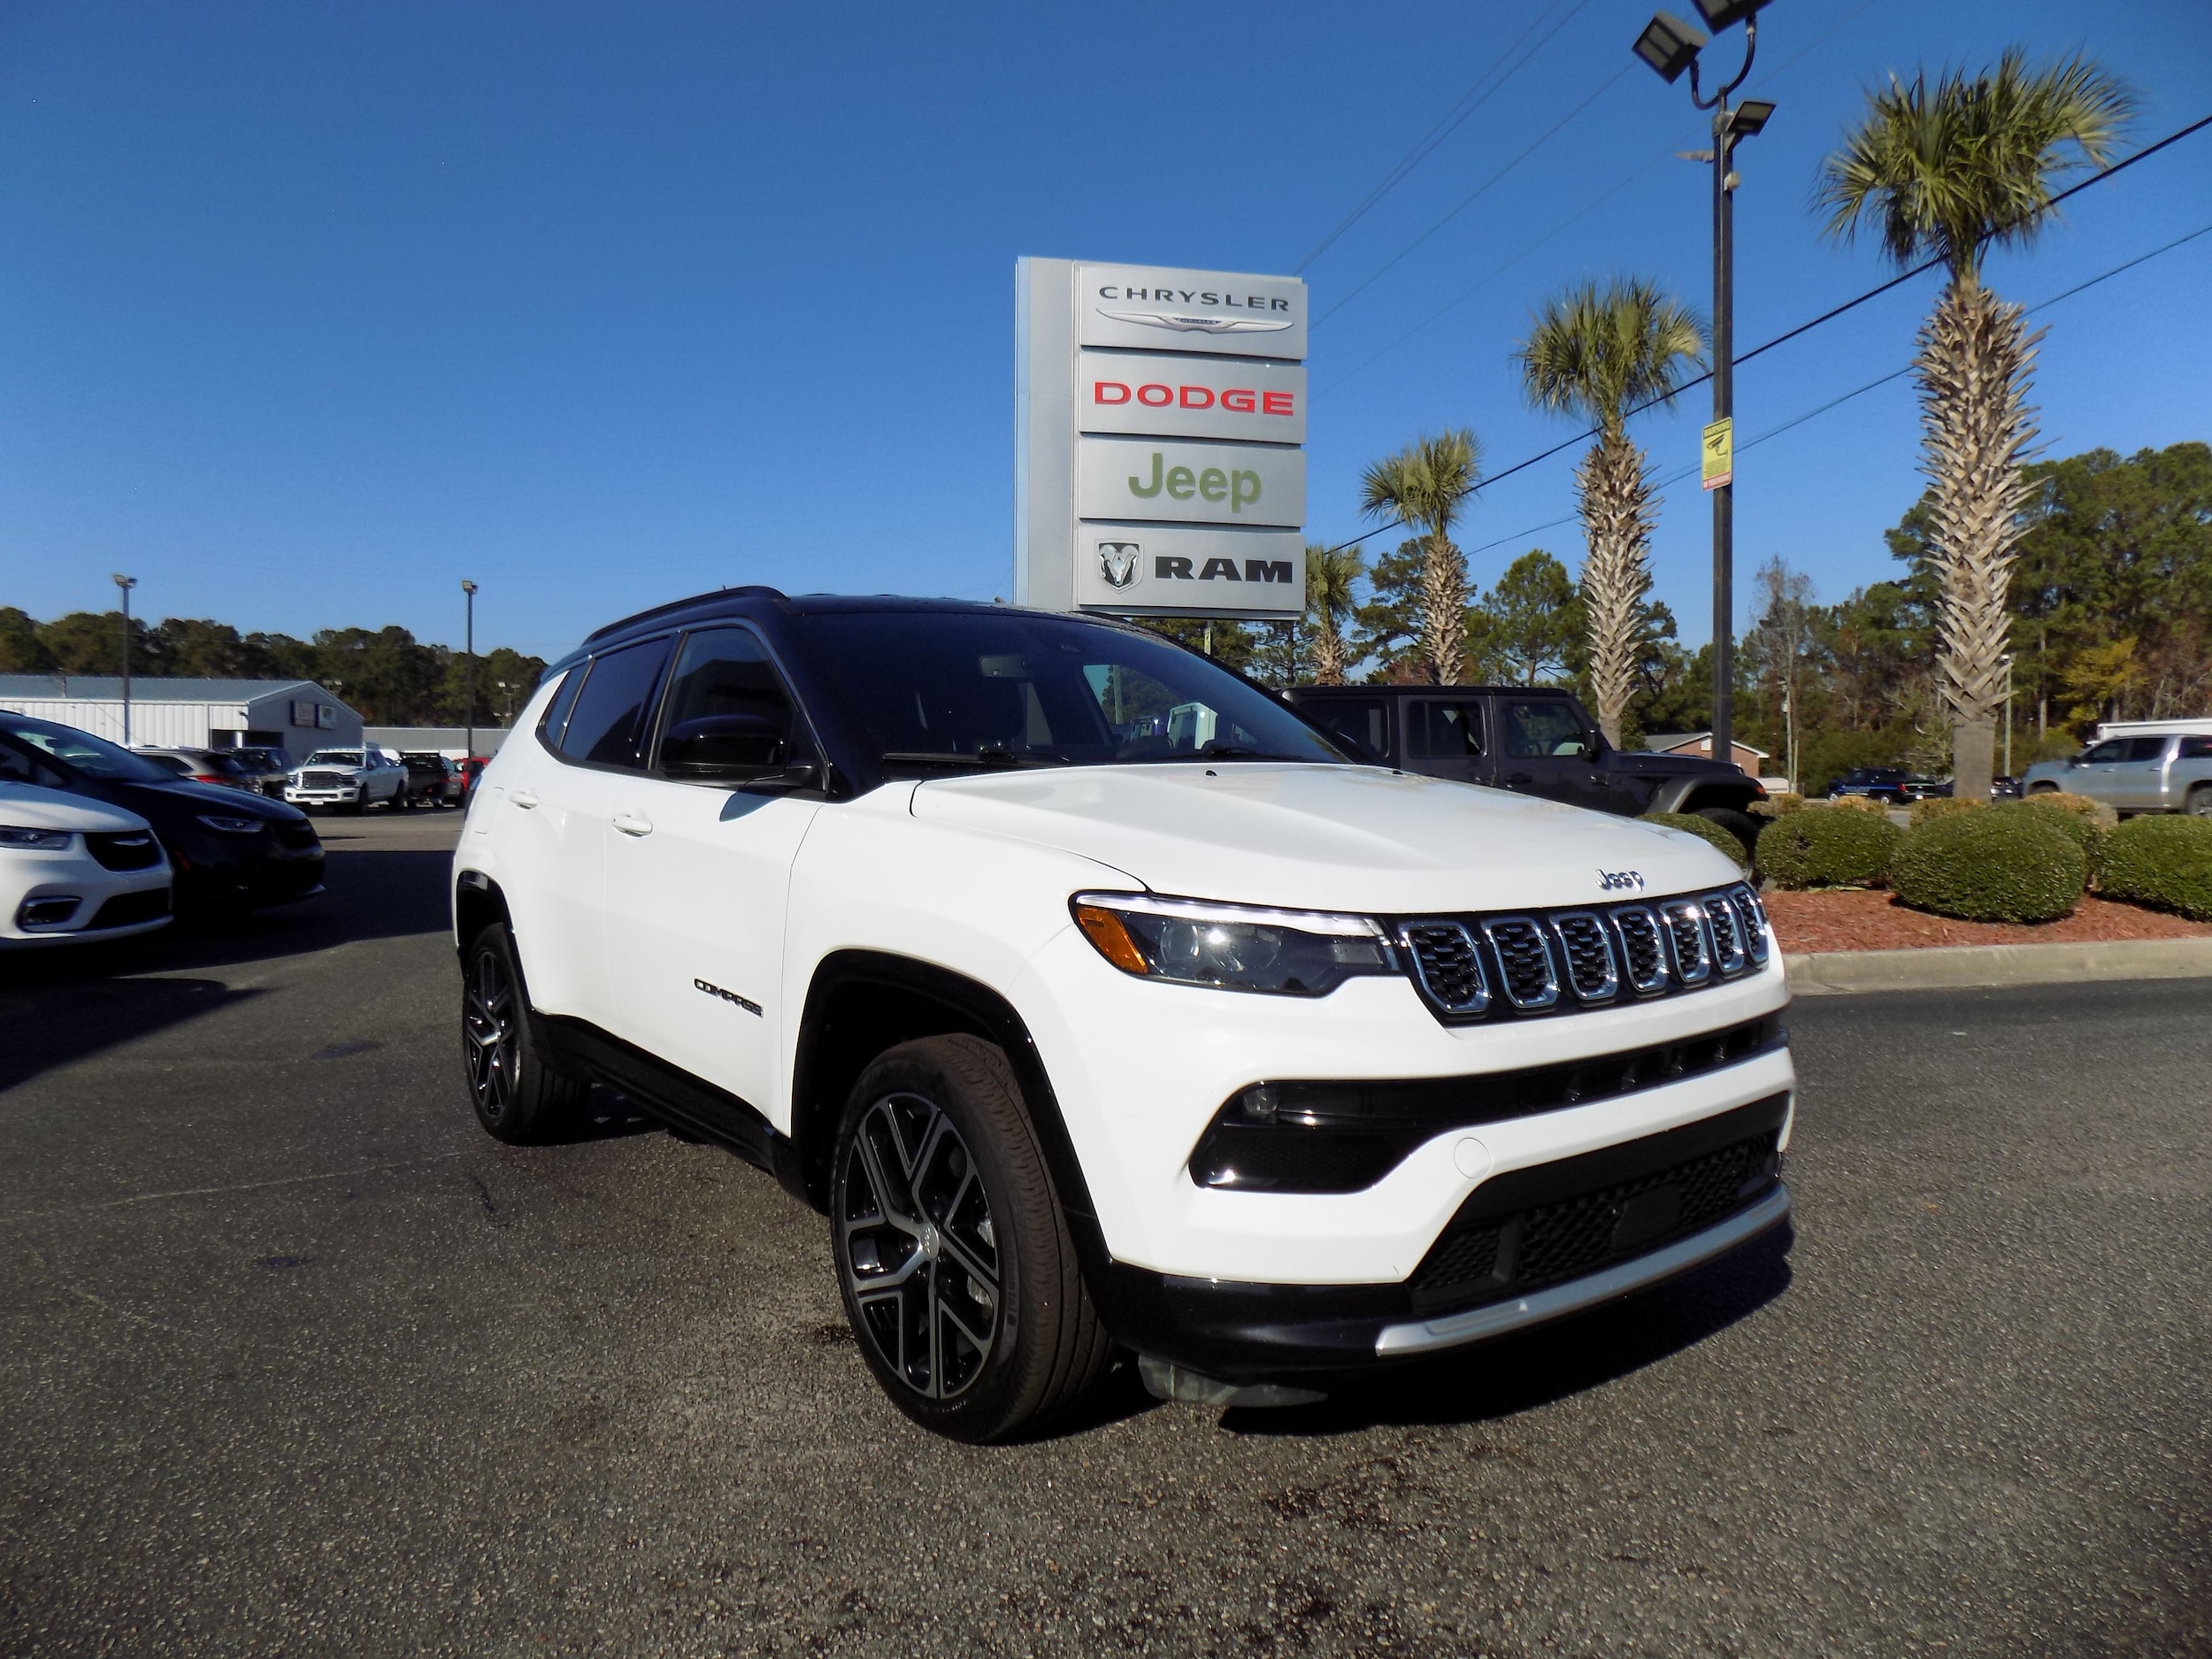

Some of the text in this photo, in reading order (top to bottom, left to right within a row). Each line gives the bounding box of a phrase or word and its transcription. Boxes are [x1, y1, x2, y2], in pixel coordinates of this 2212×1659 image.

[1098, 286, 1289, 312] CHRYSLER
[1094, 381, 1294, 416] DODGE
[1128, 452, 1262, 513] Jeep
[1155, 556, 1293, 584] RAM
[1595, 869, 1645, 892] Jeep
[695, 978, 764, 1018] COMPASS
